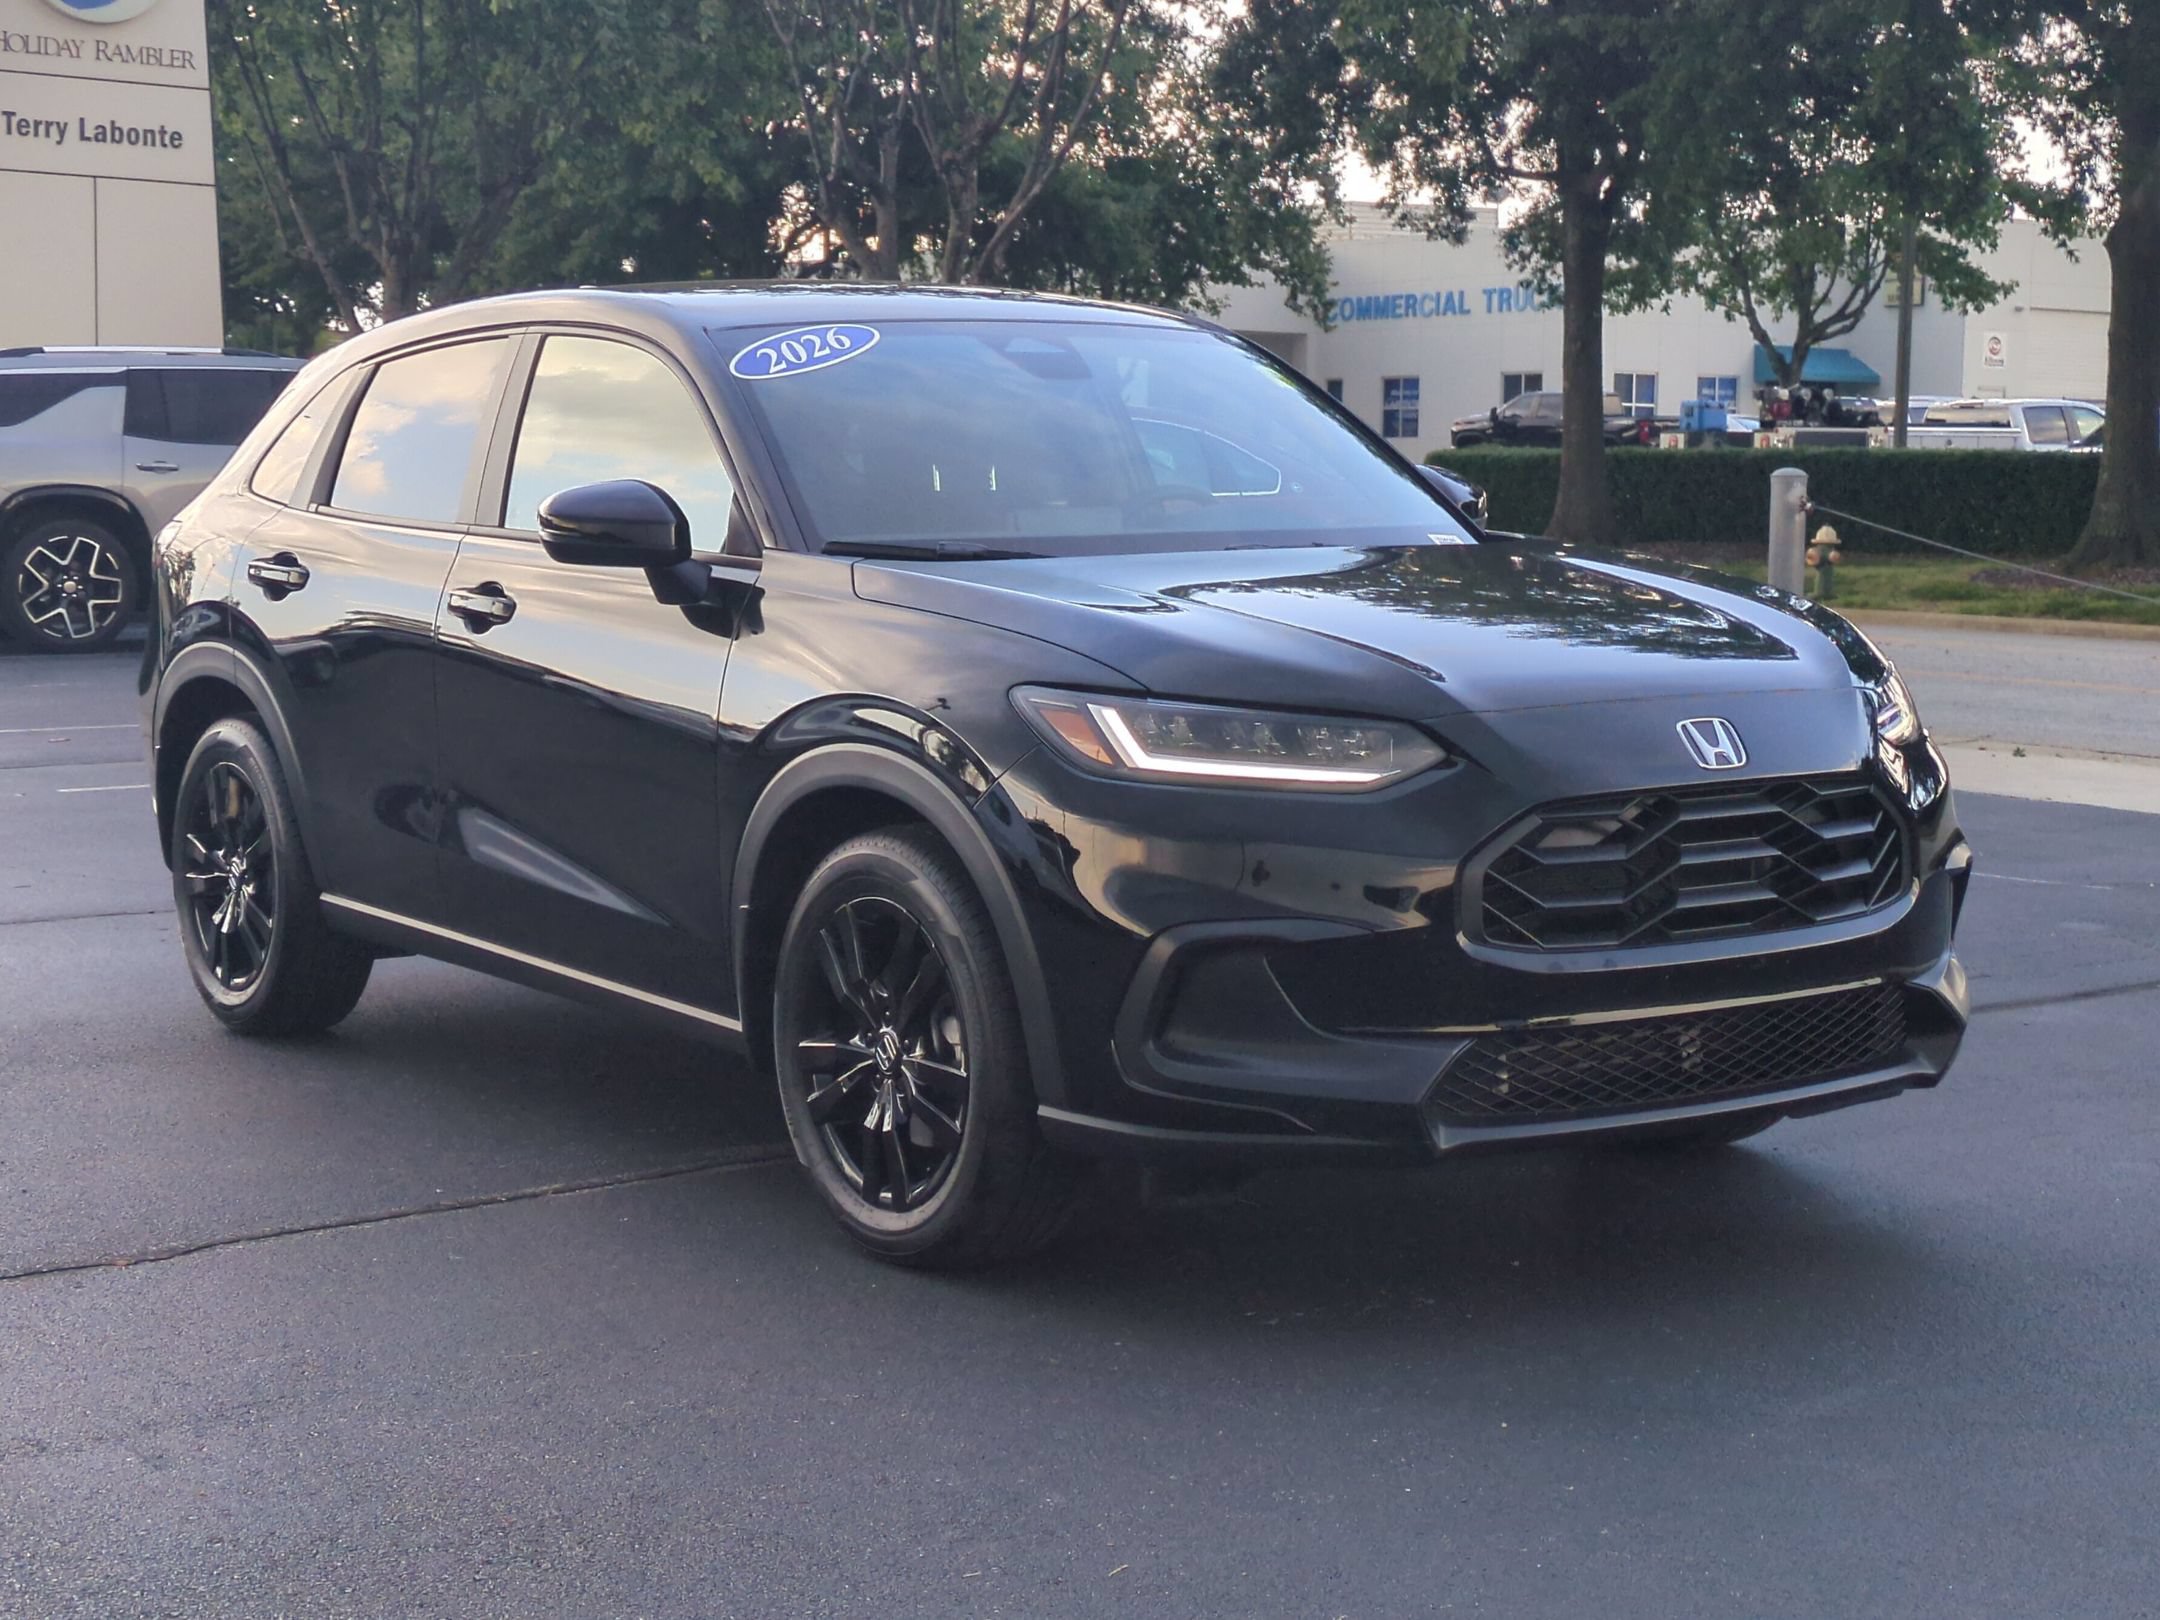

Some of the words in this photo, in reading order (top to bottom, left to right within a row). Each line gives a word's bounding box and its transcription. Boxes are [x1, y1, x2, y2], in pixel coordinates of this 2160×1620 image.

[95, 40, 196, 70] RAMBLER
[2, 110, 68, 145] Terry
[79, 117, 183, 149] Labonte
[756, 327, 852, 374] 2026
